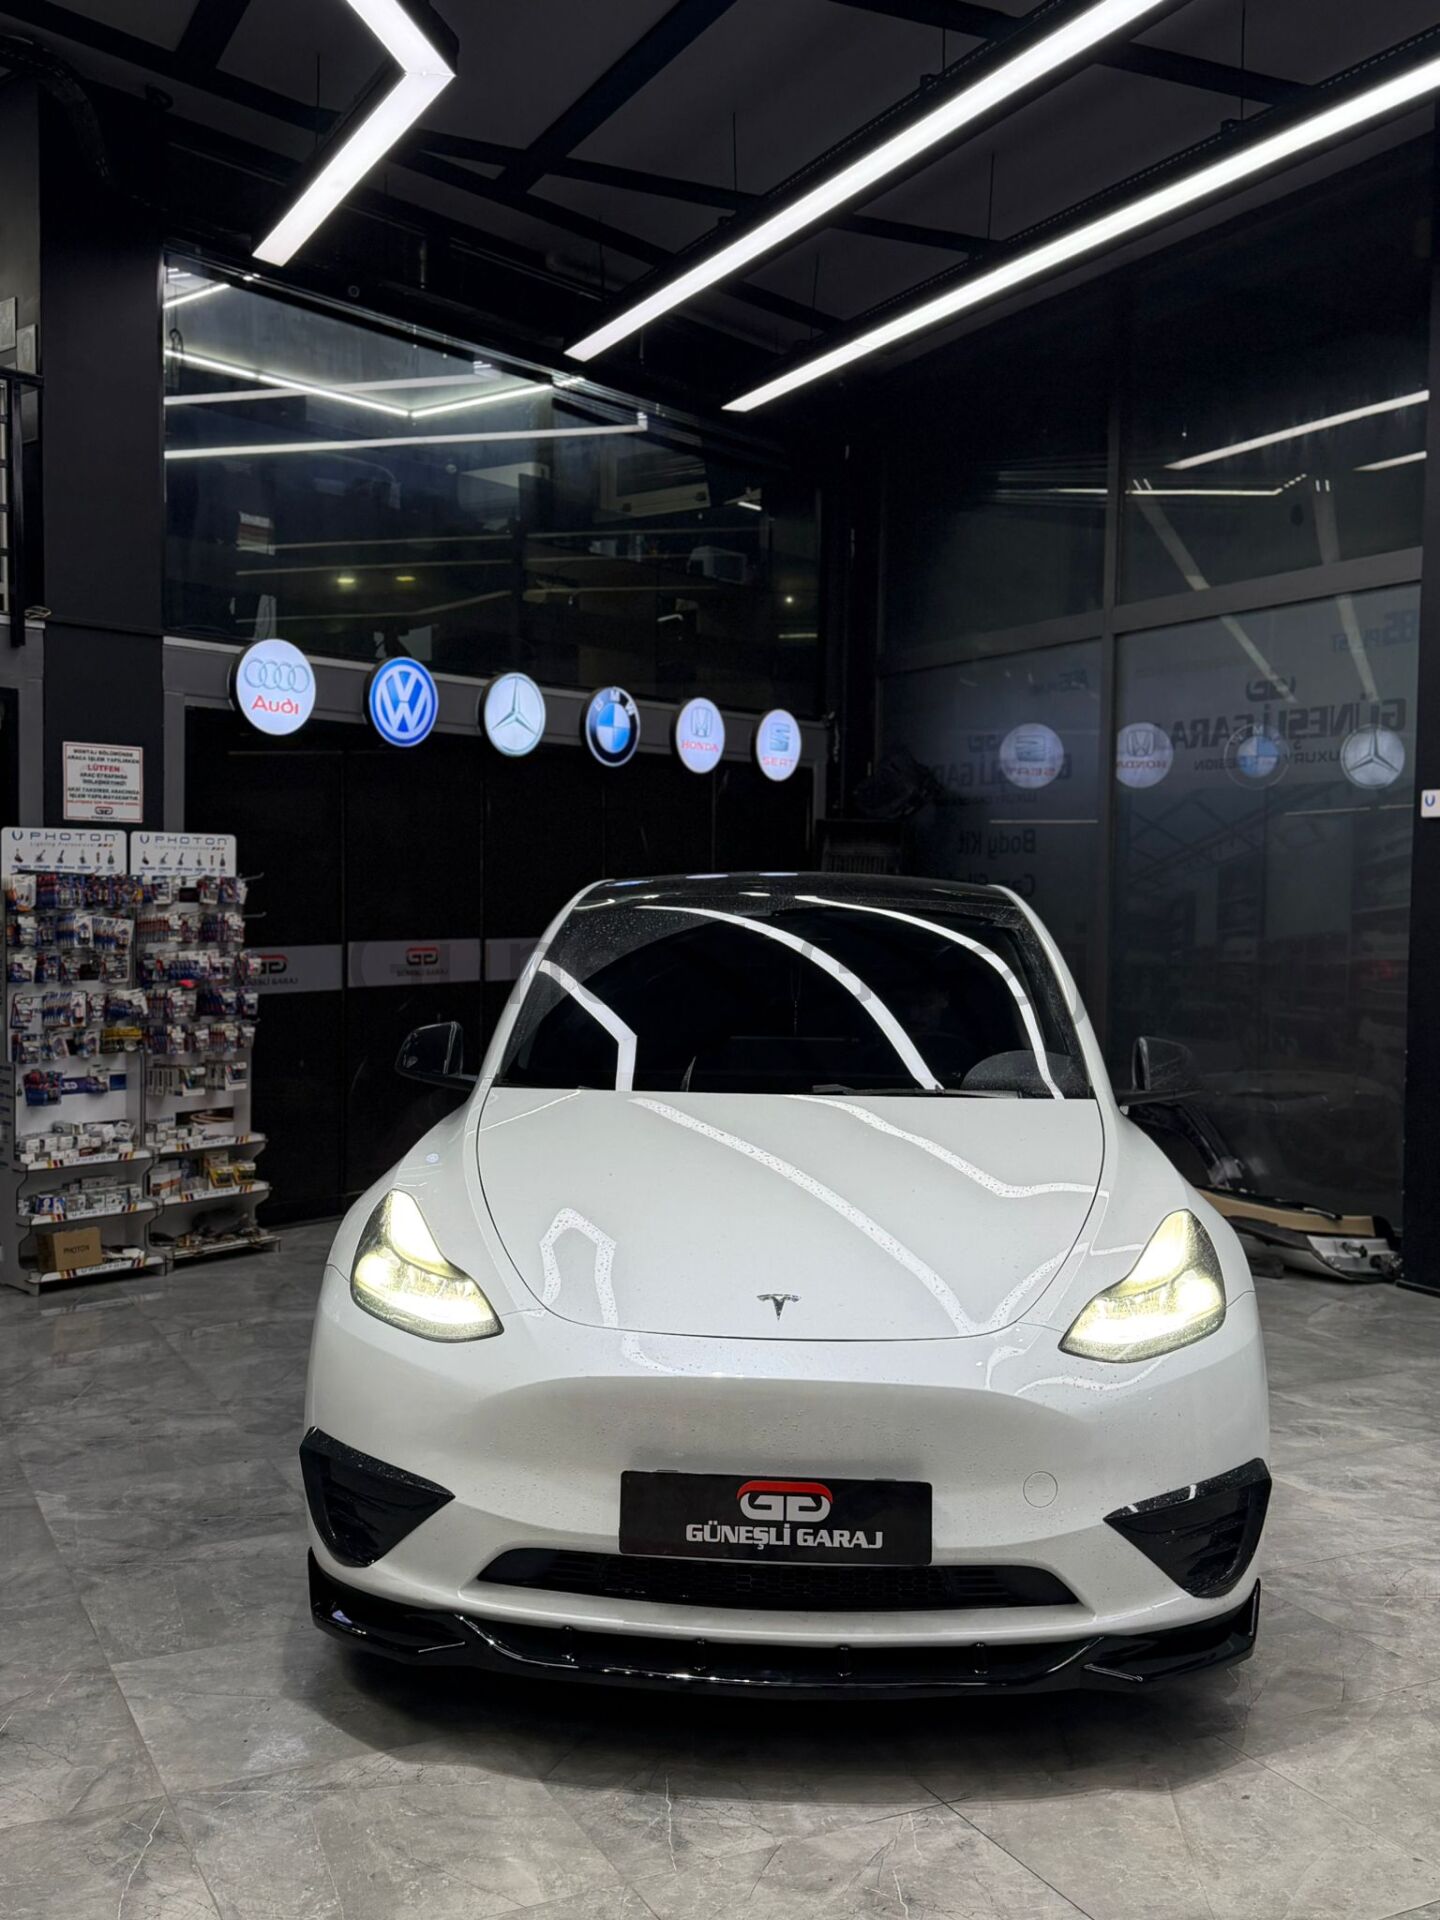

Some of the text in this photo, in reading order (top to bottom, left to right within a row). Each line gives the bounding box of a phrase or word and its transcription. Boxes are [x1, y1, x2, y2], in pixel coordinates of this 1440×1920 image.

[251, 695, 300, 716] Audi
[681, 739, 720, 754] HONDA
[87, 763, 120, 772] LÜTFEN
[686, 1520, 883, 1550] GÜNEŞLİ GARAJ
